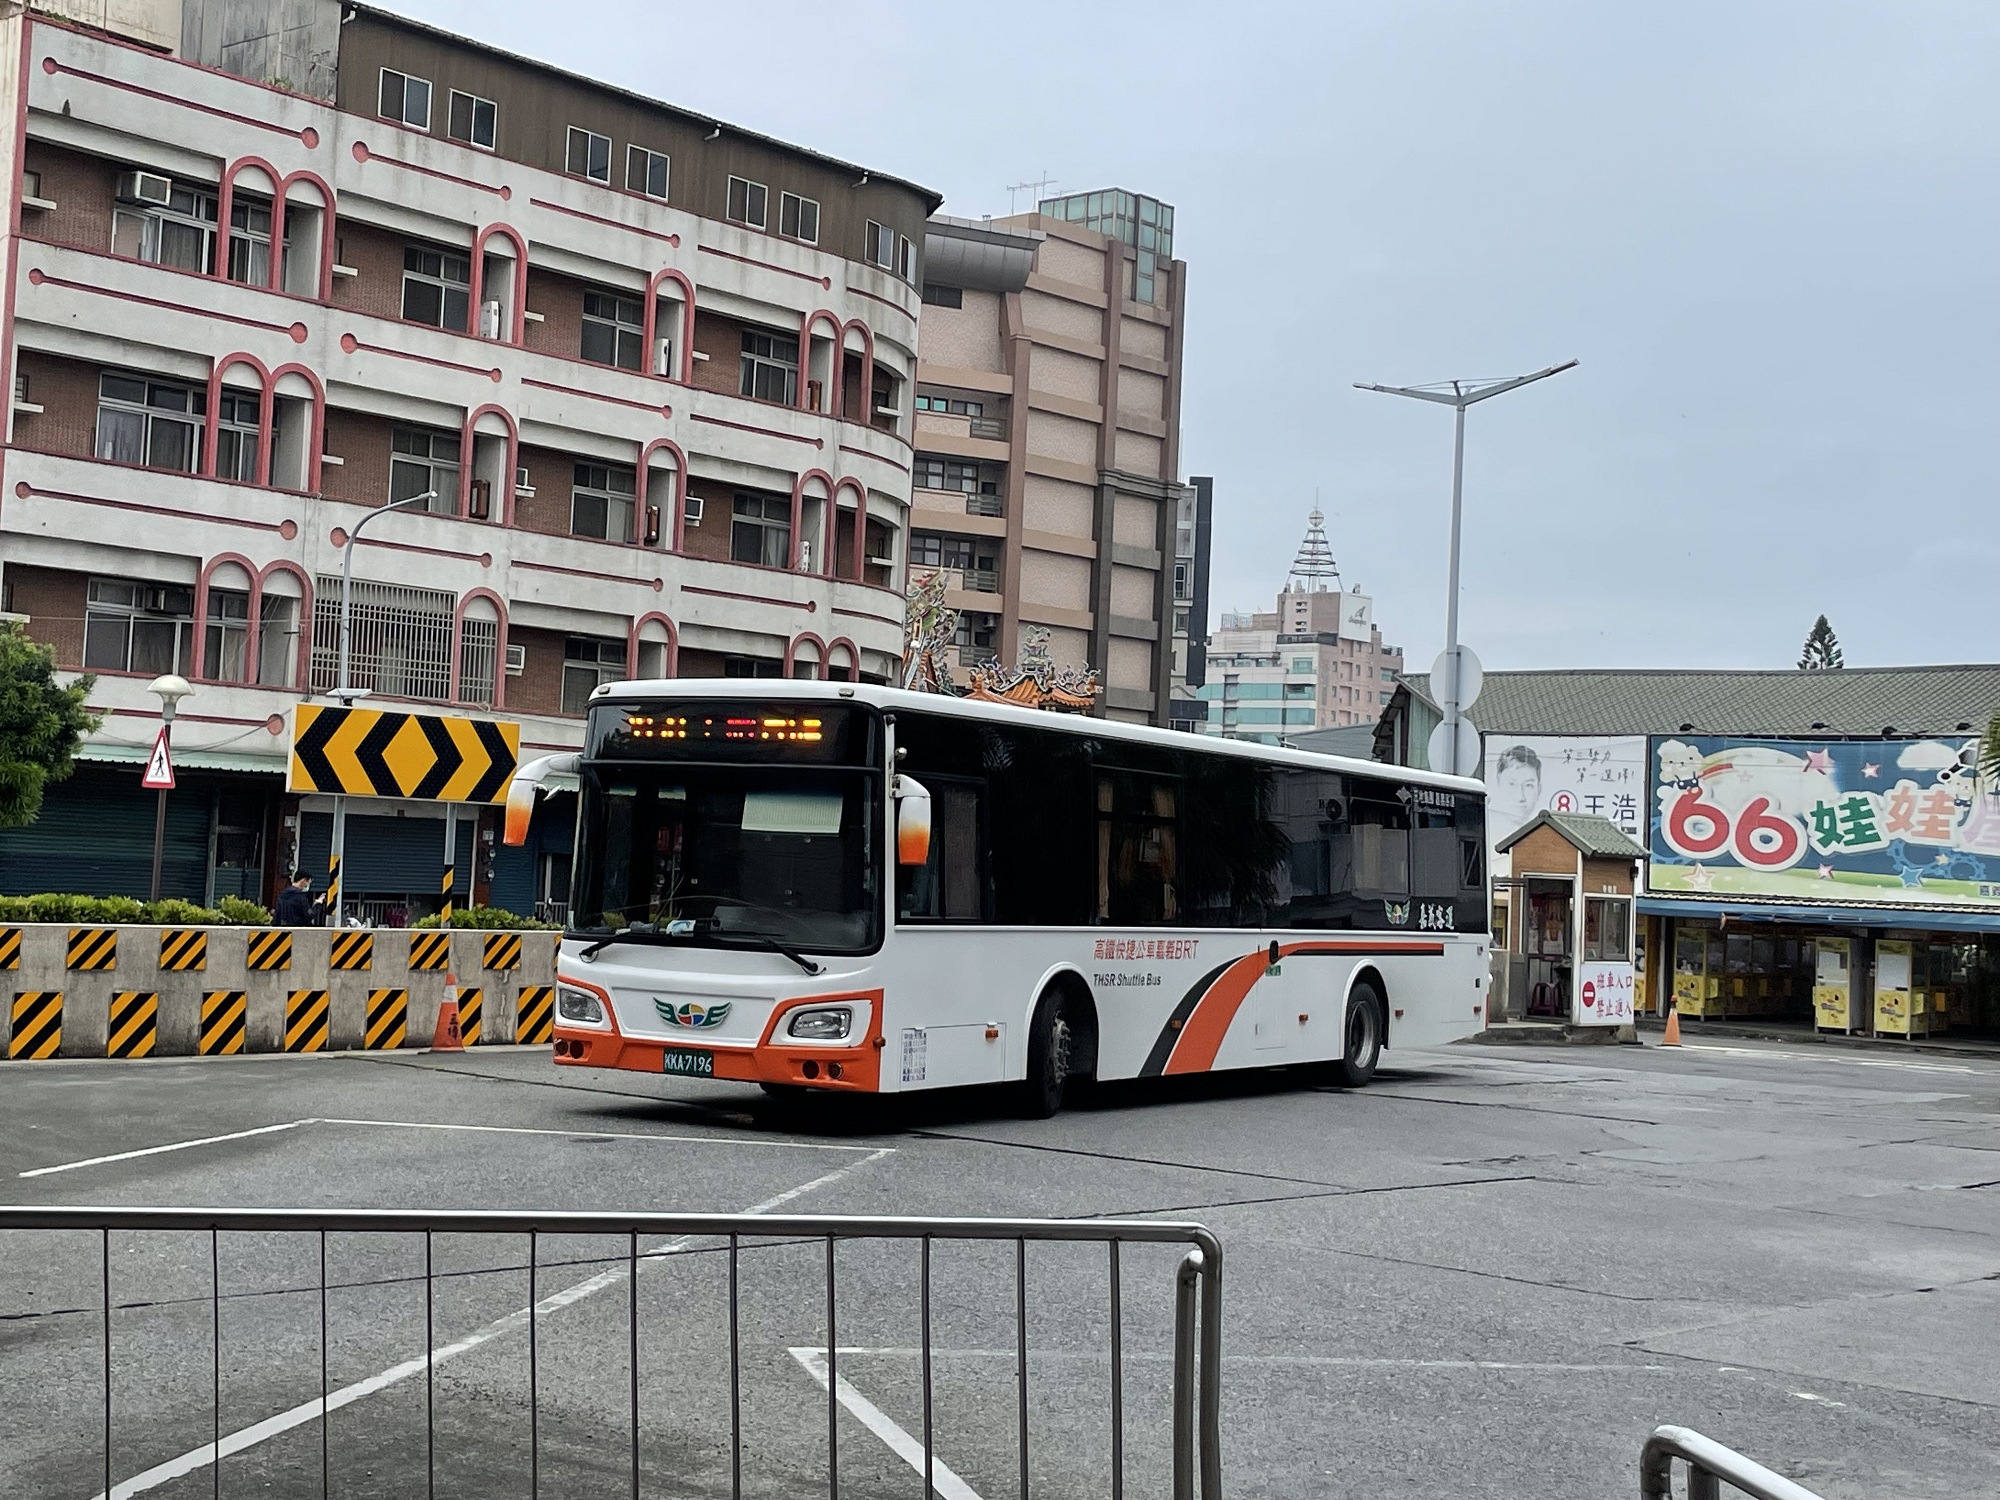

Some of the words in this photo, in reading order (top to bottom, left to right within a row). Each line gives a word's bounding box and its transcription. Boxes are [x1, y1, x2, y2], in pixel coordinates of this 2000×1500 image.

[1093, 973, 1116, 987] THSR
[1117, 972, 1146, 987] Shuttle
[1146, 972, 1162, 986] Bus
[1596, 971, 1633, 992] 班車入口
[1596, 996, 1633, 1018] 禁止進入
[664, 1053, 713, 1073] KKA-7196
